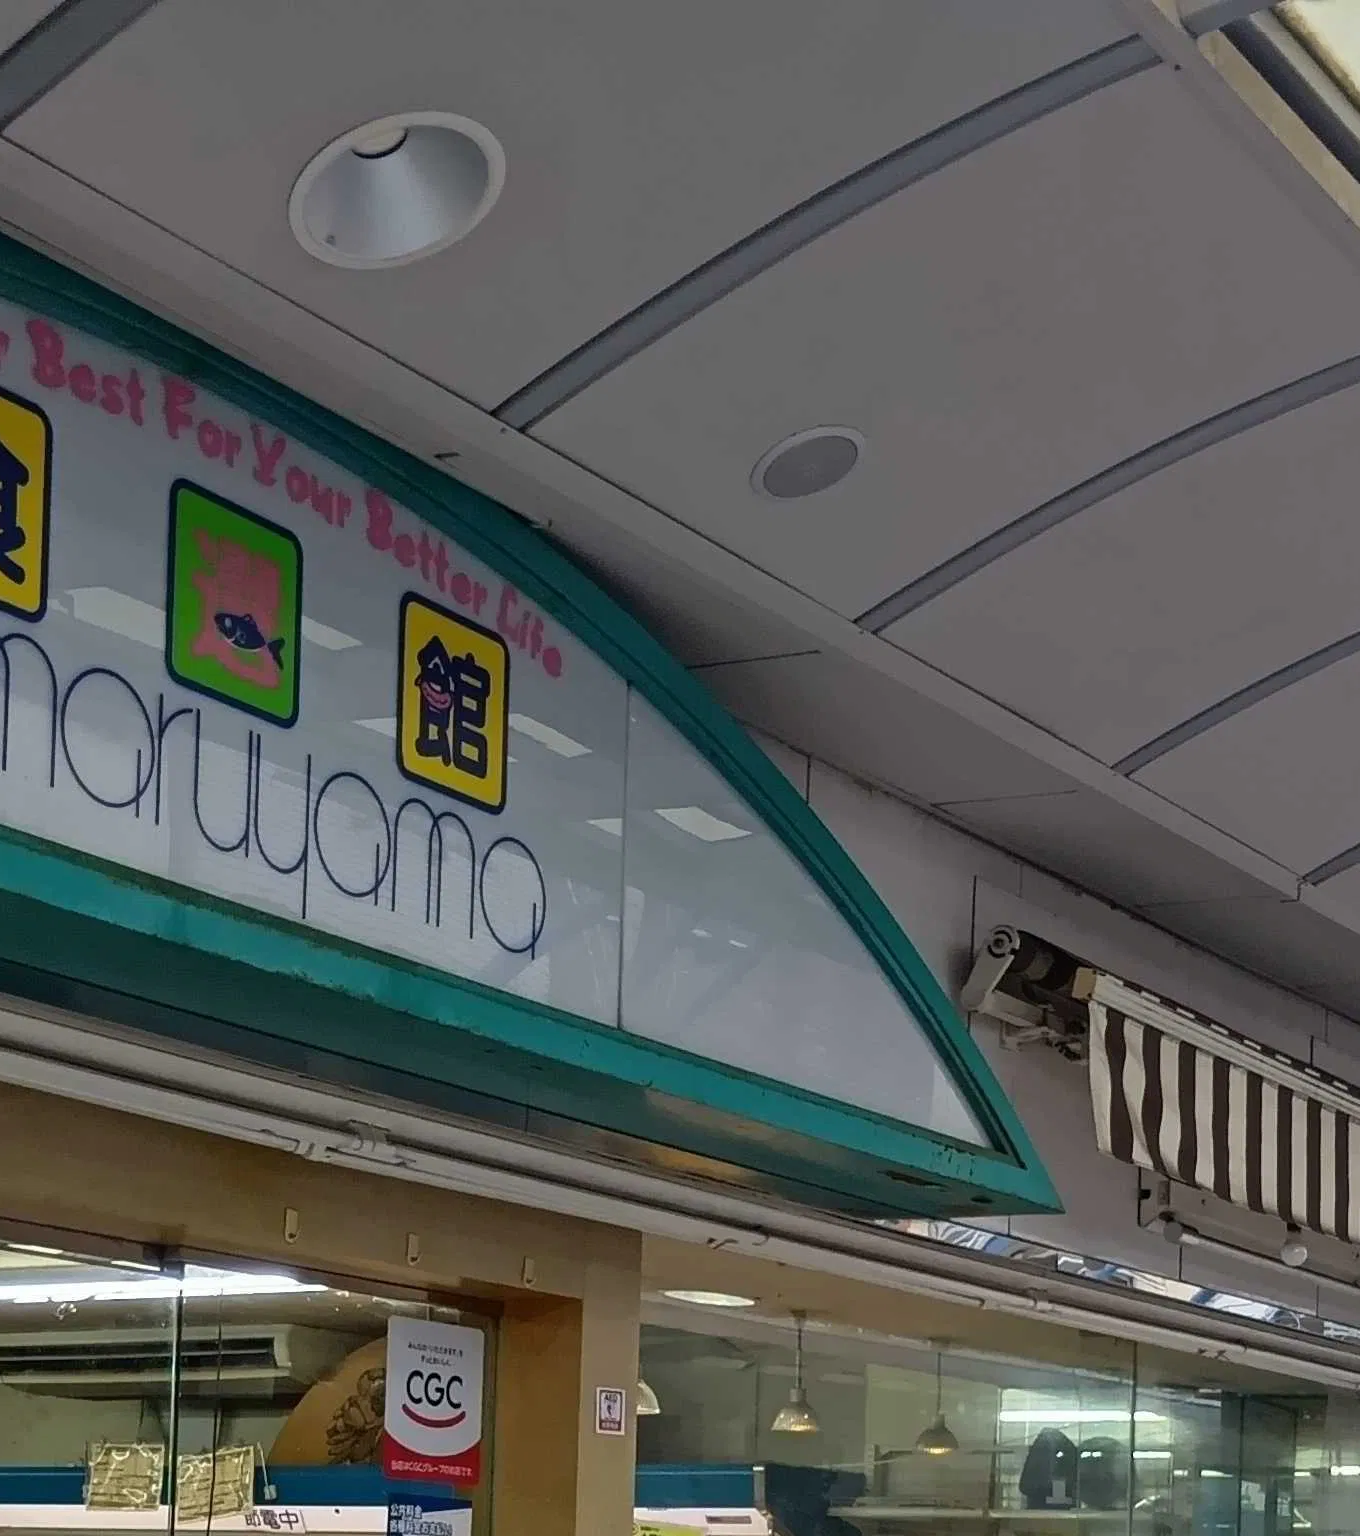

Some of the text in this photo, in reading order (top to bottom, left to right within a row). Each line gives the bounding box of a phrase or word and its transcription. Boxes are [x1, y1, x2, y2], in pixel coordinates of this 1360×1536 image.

[25, 318, 146, 427] Best
[162, 375, 242, 469] For
[250, 421, 353, 529] Your
[364, 487, 489, 617] Better
[495, 584, 564, 680] Life
[405, 1369, 464, 1410] CGC
